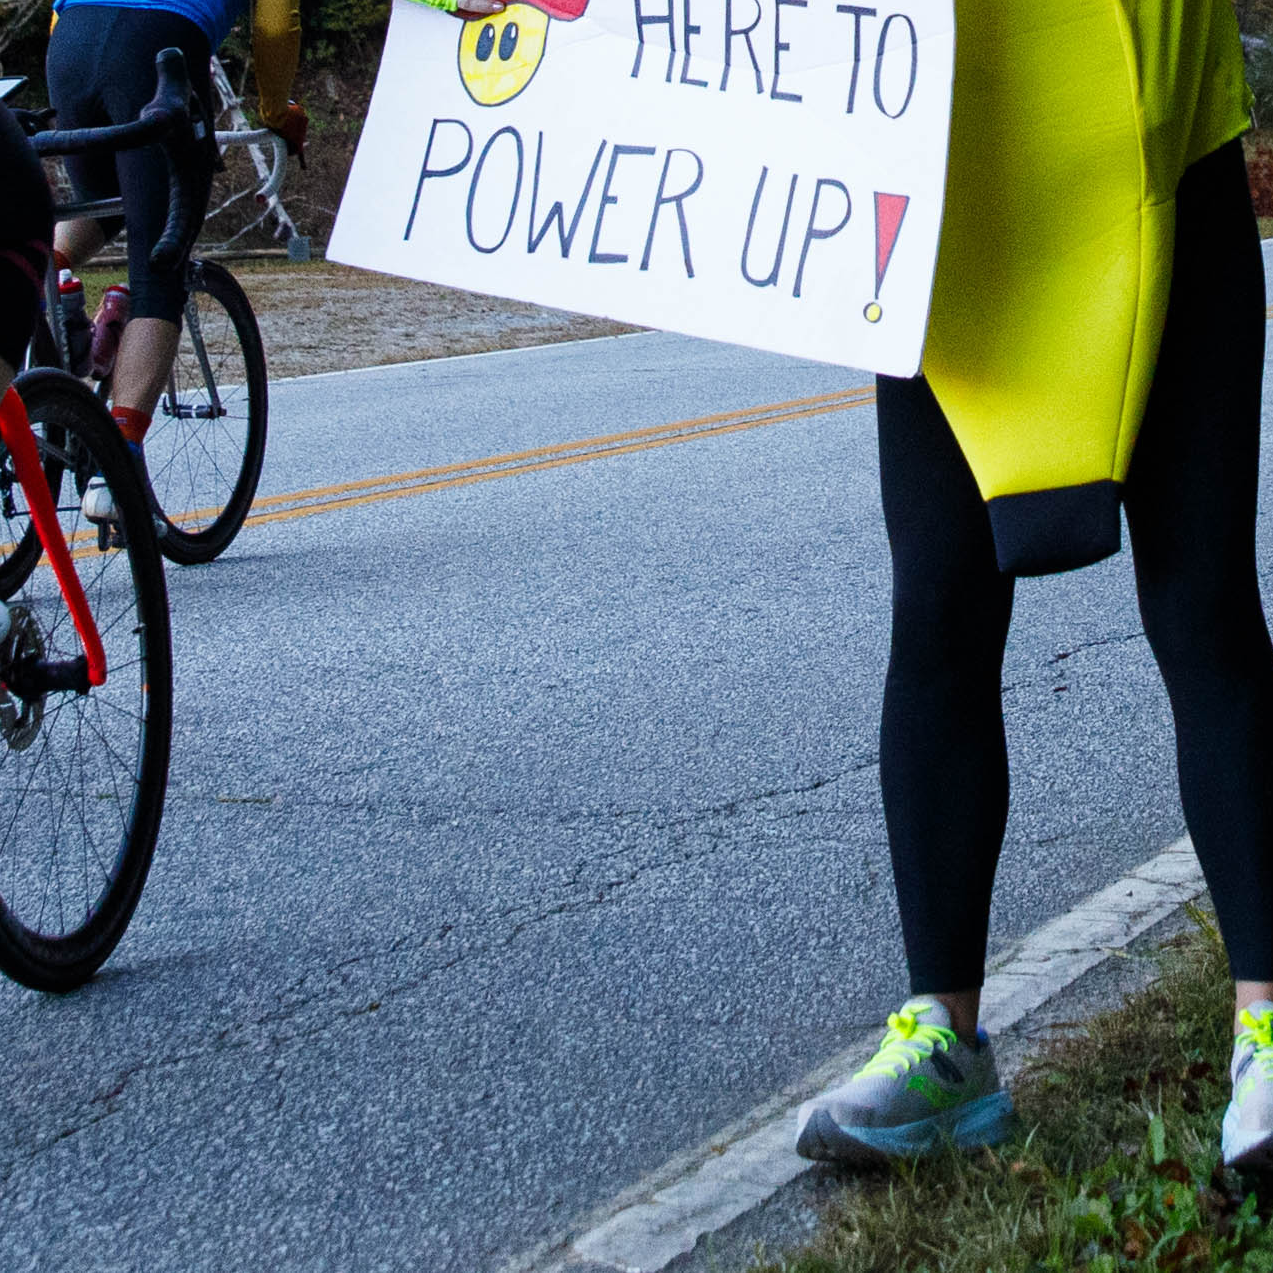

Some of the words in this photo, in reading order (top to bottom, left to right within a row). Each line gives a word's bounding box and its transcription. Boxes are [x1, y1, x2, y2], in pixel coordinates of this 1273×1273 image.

[834, 4, 919, 120] TO
[403, 117, 706, 279] POWER
[740, 165, 911, 325] UP!
